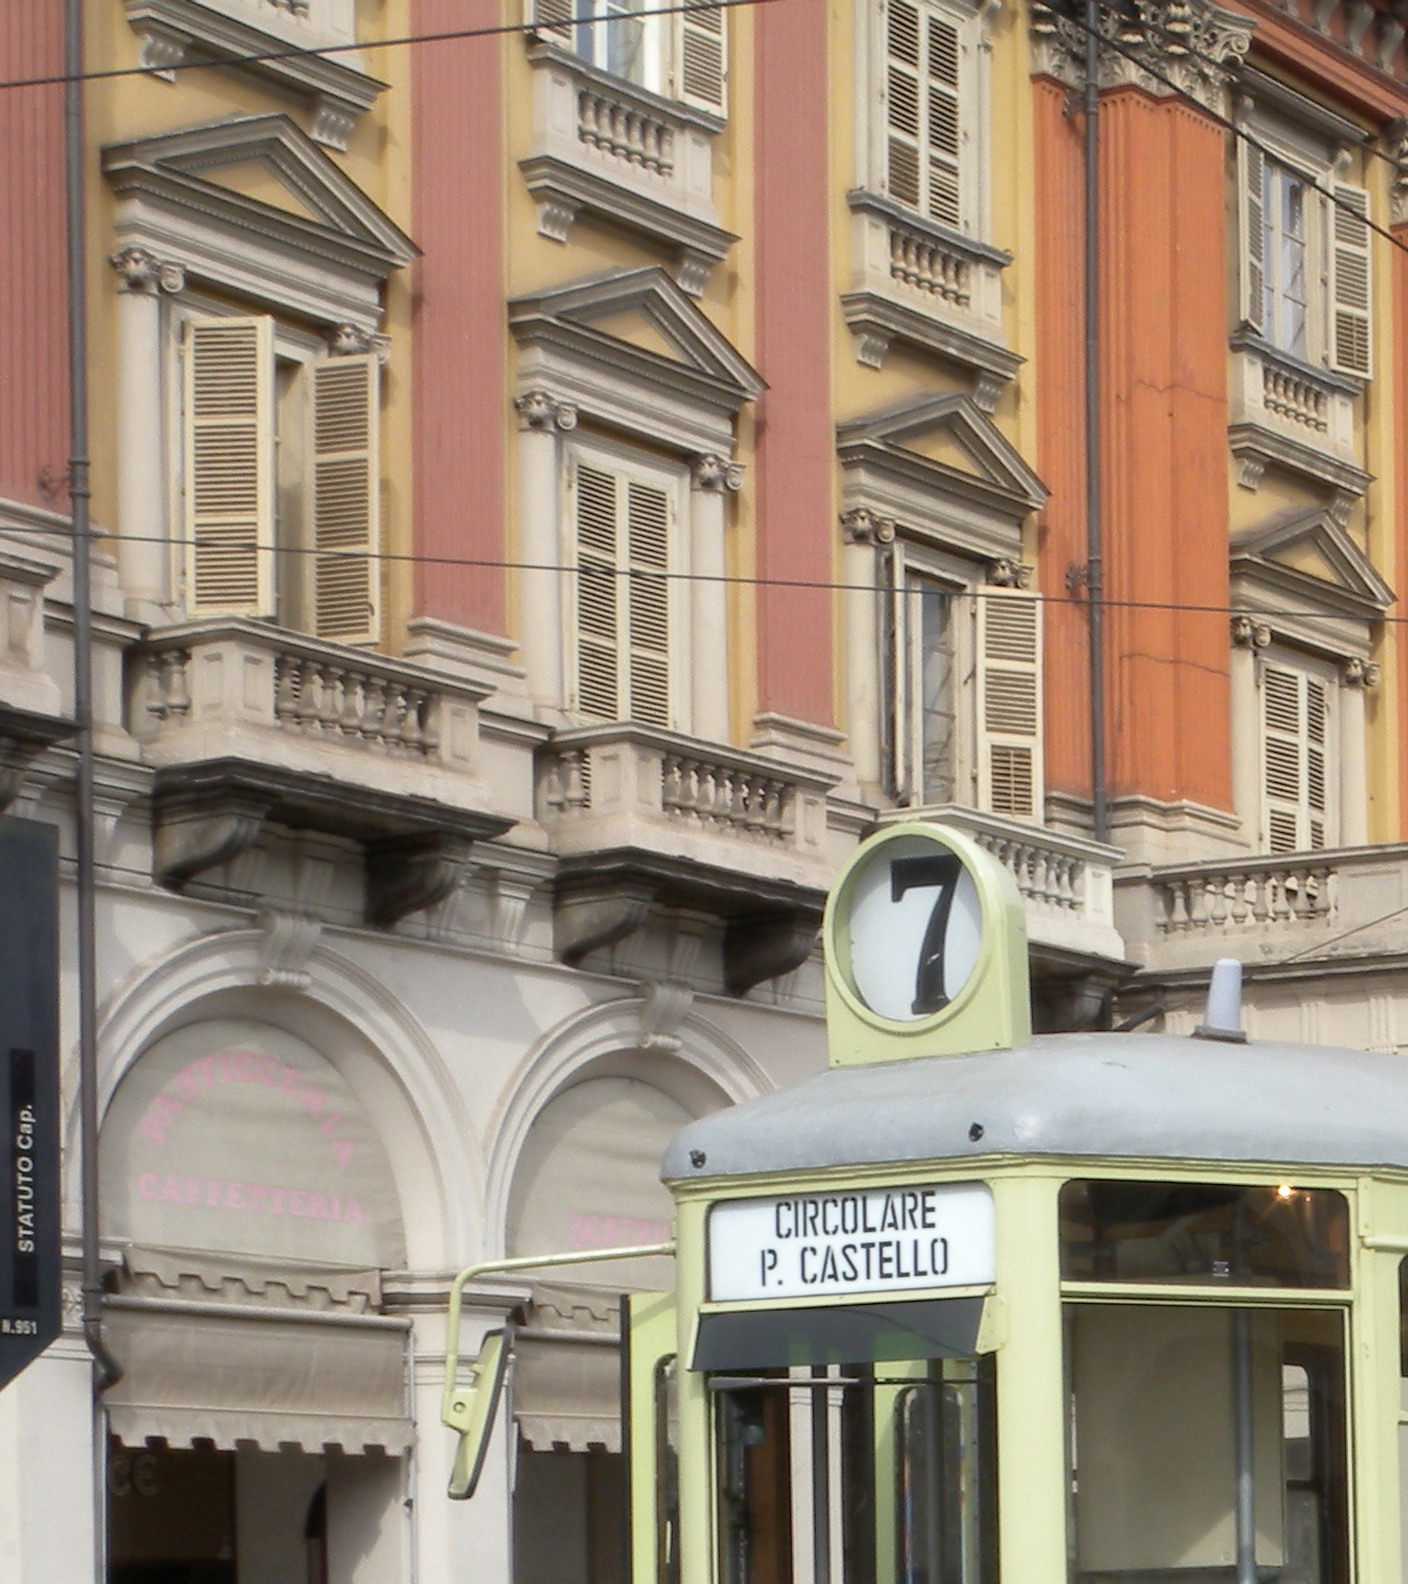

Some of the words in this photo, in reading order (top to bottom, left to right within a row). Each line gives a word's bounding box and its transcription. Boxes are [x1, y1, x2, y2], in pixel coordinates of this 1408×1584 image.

[890, 854, 963, 1014] 7
[16, 1104, 37, 1150] Cap.
[139, 1050, 358, 1172] PASTICCERIA
[16, 1157, 34, 1253] STATUTO
[137, 1172, 366, 1225] CAFFETTERIA
[774, 1190, 937, 1240] CIRCOLARE
[761, 1248, 783, 1287] P.
[800, 1236, 949, 1285] CASTELLO
